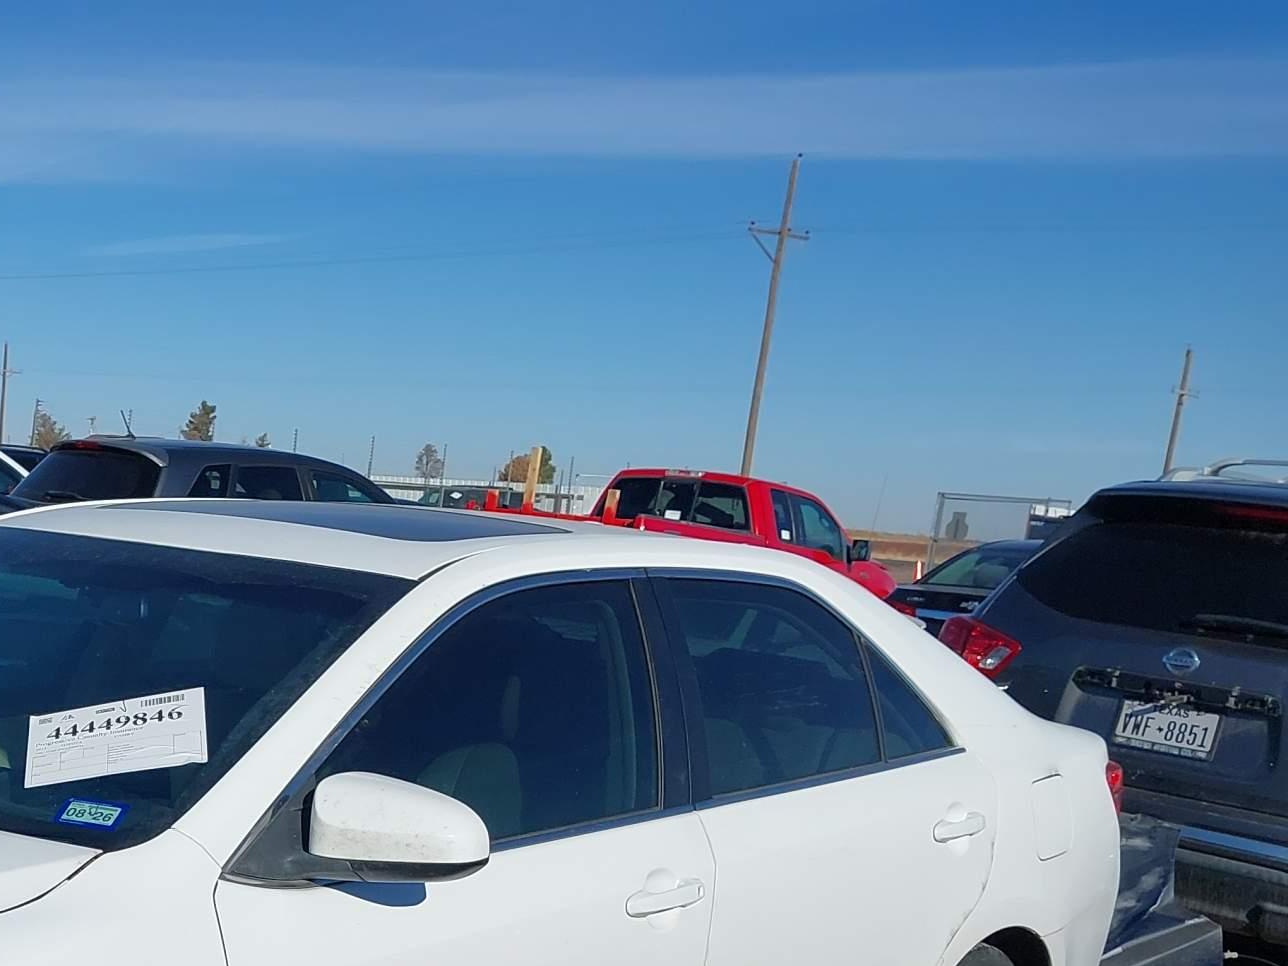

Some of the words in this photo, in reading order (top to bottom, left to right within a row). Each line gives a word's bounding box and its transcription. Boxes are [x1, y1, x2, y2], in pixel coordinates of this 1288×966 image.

[46, 704, 189, 740] 44449846
[65, 807, 87, 819] 08
[92, 811, 114, 823] 26
